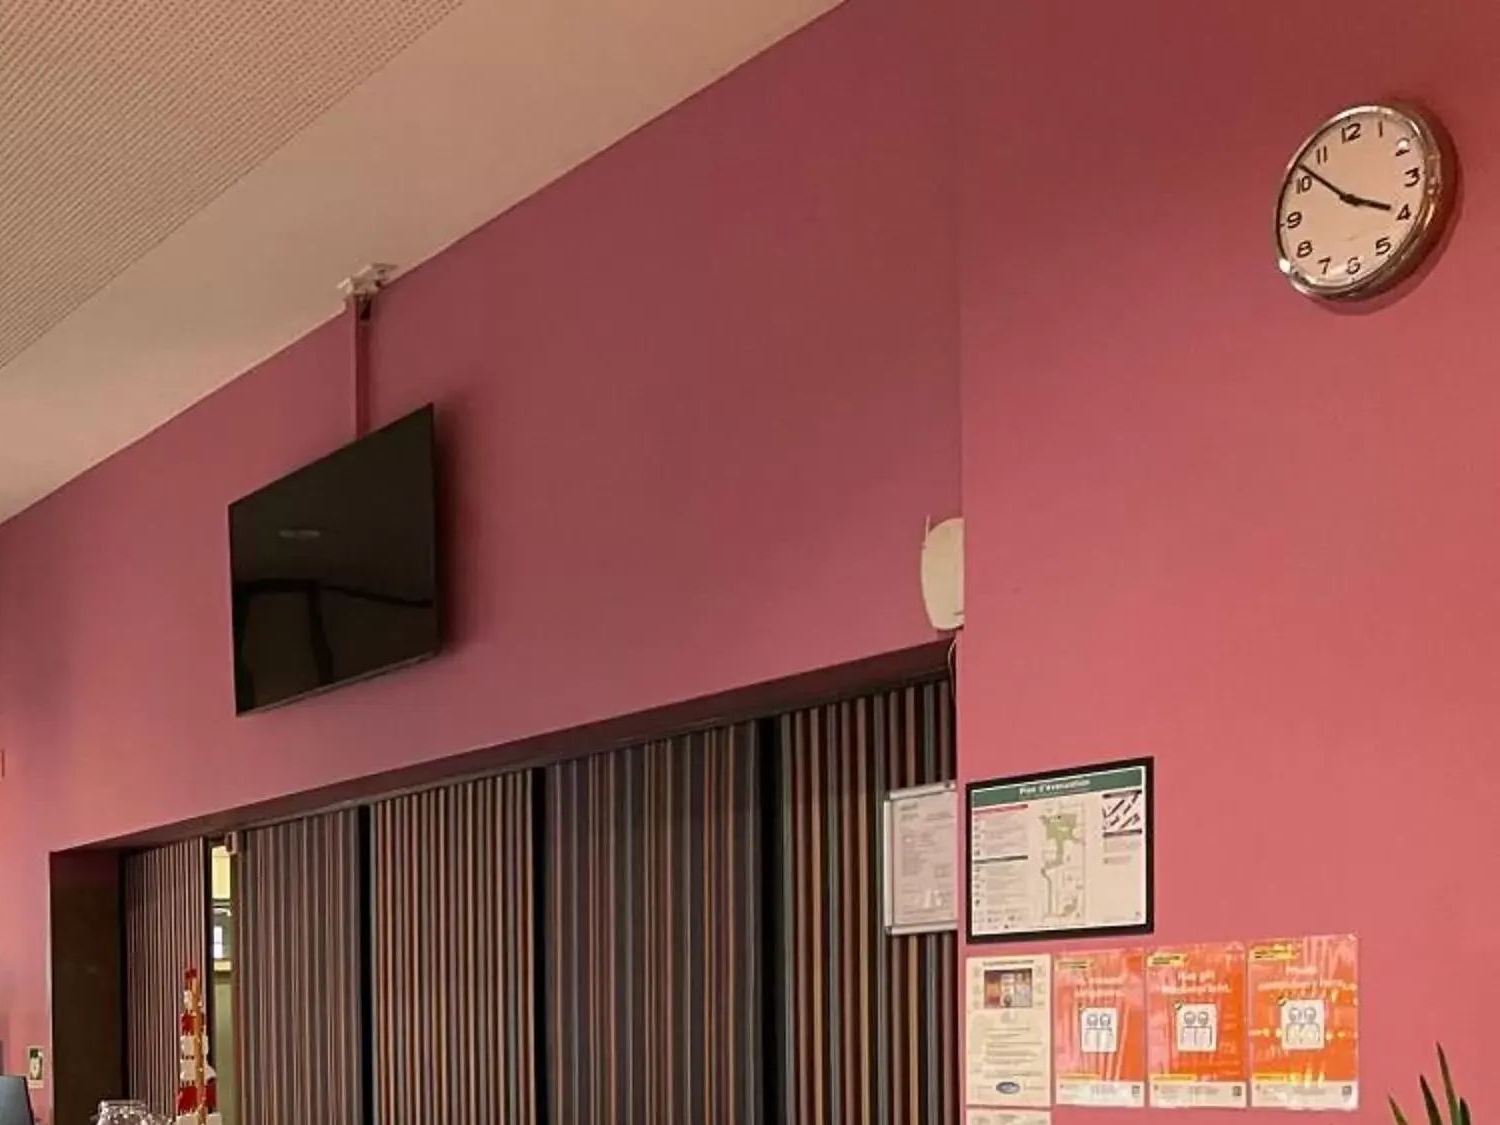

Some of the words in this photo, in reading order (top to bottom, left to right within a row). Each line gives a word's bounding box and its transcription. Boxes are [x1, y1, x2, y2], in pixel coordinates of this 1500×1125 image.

[1341, 123, 1361, 144] 12
[1377, 120, 1384, 137] 1
[1316, 145, 1329, 164] 11
[1296, 175, 1312, 194] 10
[1404, 167, 1421, 187] 3
[1286, 211, 1302, 228] 9
[1396, 203, 1411, 221] 4
[1296, 240, 1313, 258] 8
[1375, 237, 1391, 255] 5
[1317, 257, 1331, 275] 7
[1347, 257, 1361, 274] 6
